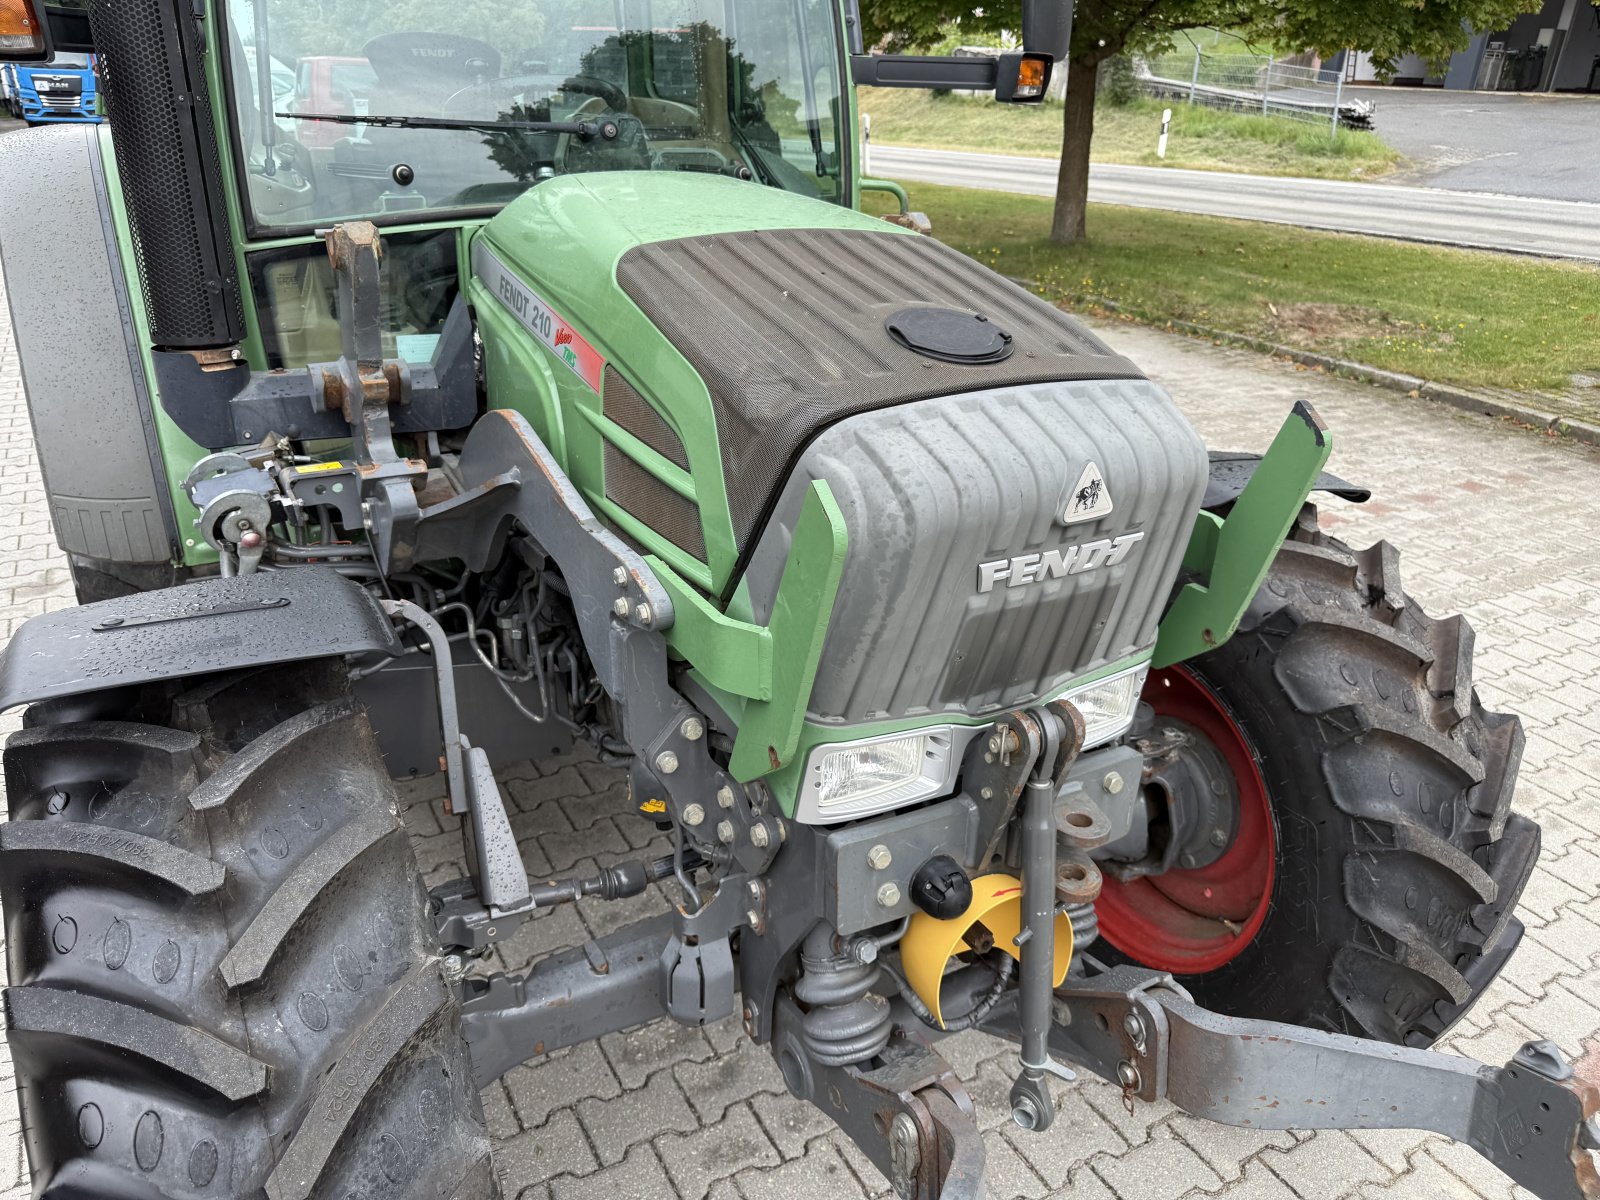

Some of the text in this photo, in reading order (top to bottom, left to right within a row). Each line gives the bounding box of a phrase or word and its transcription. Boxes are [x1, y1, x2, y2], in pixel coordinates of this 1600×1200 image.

[410, 47, 456, 58] FENDT
[500, 275, 552, 339] FENDT 210
[563, 346, 577, 368] TMS
[977, 531, 1145, 594] FENDT
